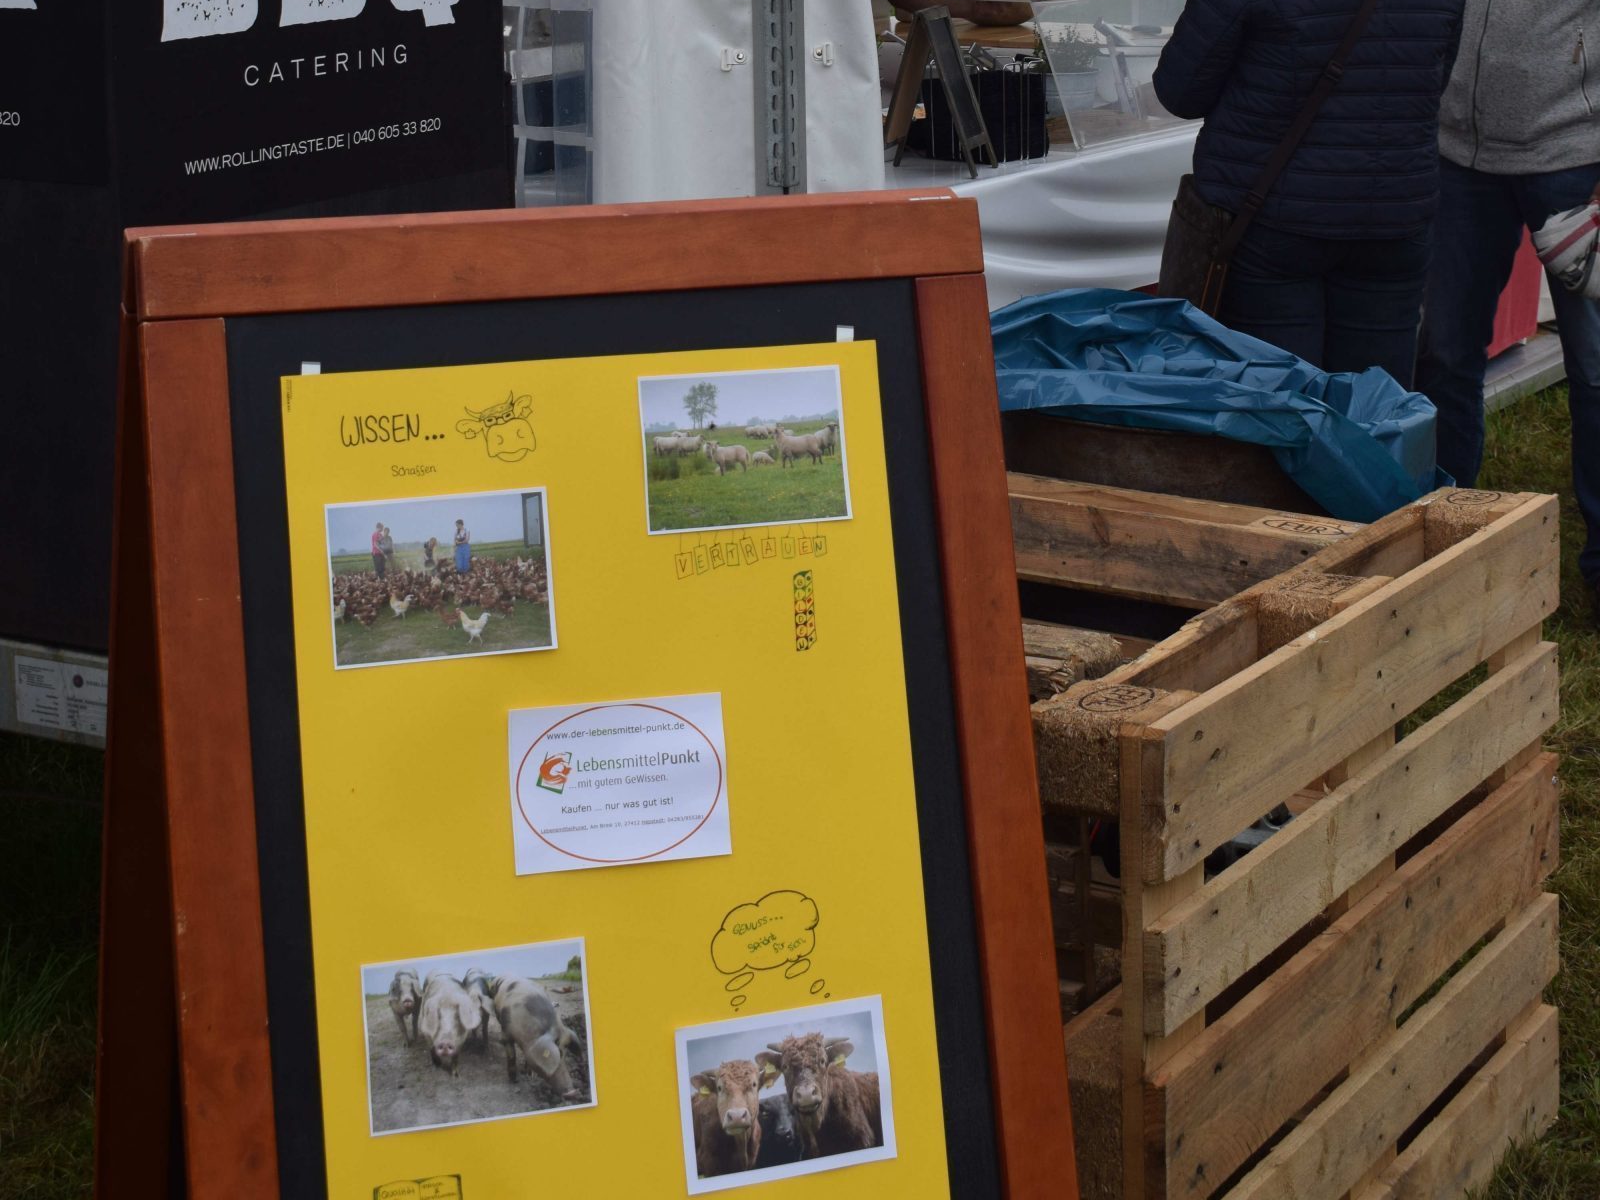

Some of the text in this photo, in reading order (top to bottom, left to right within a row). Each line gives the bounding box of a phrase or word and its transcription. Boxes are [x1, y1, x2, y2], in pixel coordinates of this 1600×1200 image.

[243, 44, 408, 87] CATERING
[184, 133, 345, 176] WWW.ROLLINGTASTE.DE
[353, 128, 376, 145] 040
[378, 123, 400, 141] 605
[402, 121, 417, 136] 33
[419, 117, 442, 133] 820
[677, 539, 825, 575] VERTRAUEN
[546, 722, 686, 741] www.der-lebensmittel-punkt.de
[576, 749, 700, 773] LebensmittelPunkt
[594, 776, 623, 790] gutem
[561, 804, 593, 815] Kaufen
[605, 802, 620, 811] nur
[623, 800, 640, 809] was
[642, 799, 658, 809] gut
